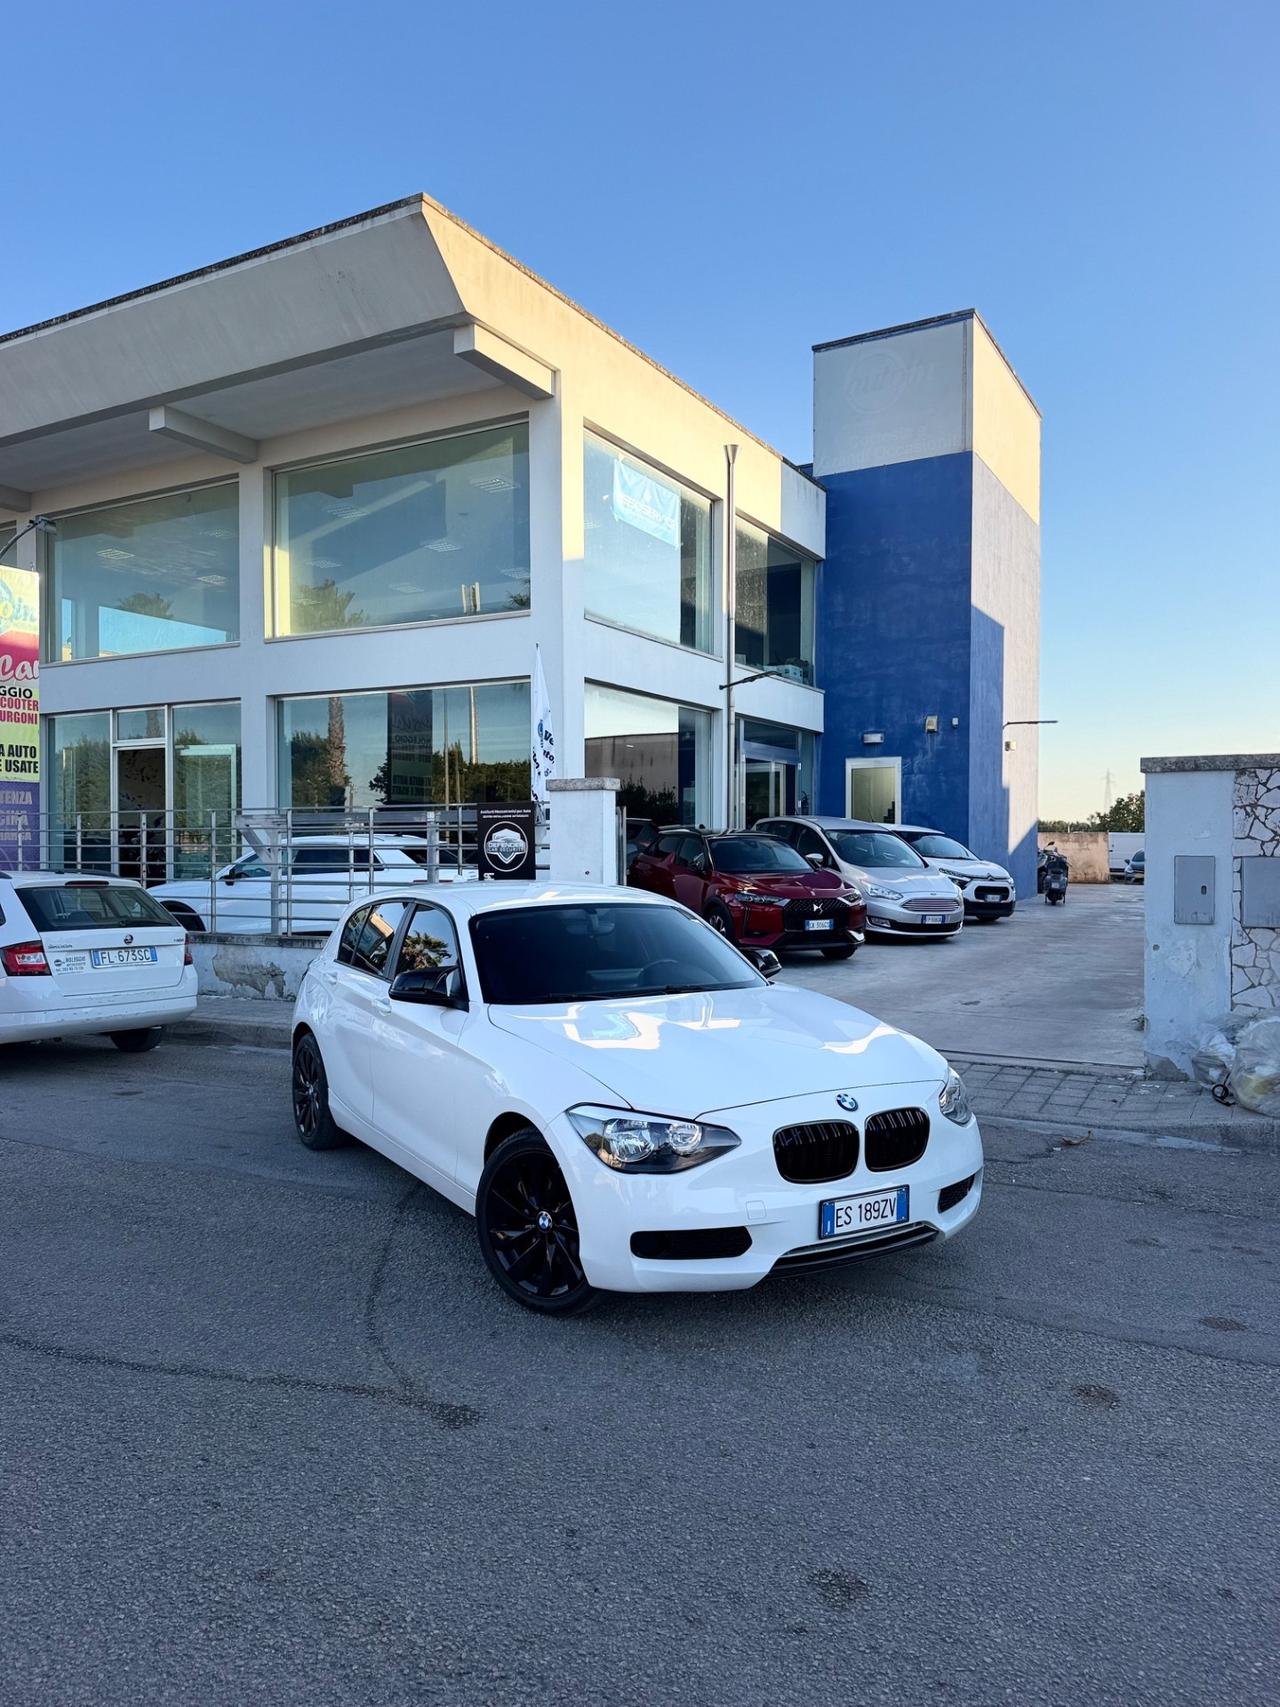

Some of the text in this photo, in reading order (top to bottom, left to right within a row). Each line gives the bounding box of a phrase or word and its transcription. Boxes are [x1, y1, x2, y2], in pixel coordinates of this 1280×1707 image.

[0, 686, 33, 699] GGIO
[1, 697, 39, 711] COOTER
[0, 710, 37, 725] URGONI
[8, 744, 36, 759] AUTO
[5, 759, 39, 773] USATE
[101, 949, 150, 964] FL 673SC
[836, 1197, 896, 1228] ES 189ZV
